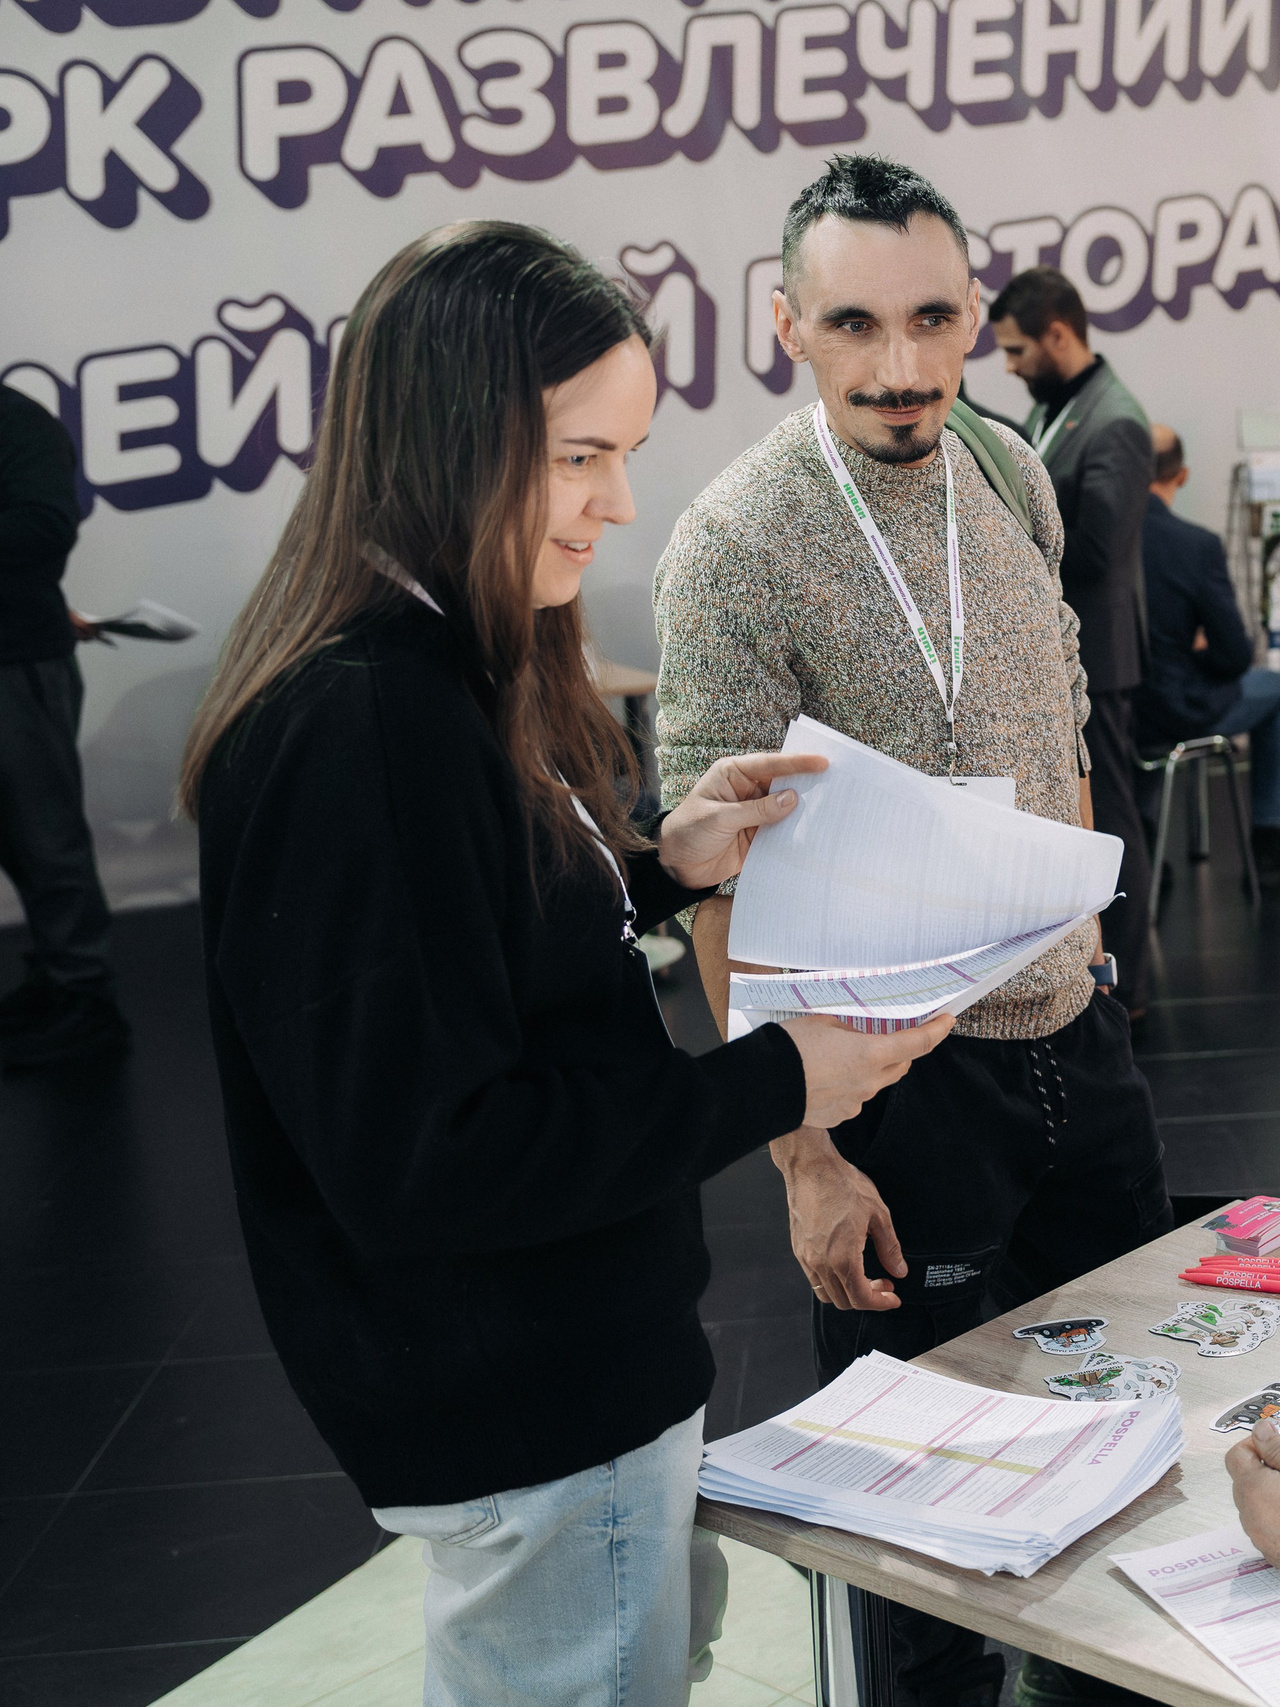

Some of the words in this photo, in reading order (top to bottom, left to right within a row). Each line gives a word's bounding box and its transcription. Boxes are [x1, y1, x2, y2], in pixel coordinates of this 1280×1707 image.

[917, 627, 938, 664] irwin
[954, 636, 962, 674] irwin
[1216, 1276, 1261, 1289] POSPELLA
[1088, 1410, 1141, 1466] POSPELLA
[1147, 1546, 1244, 1578] POSPELLA
